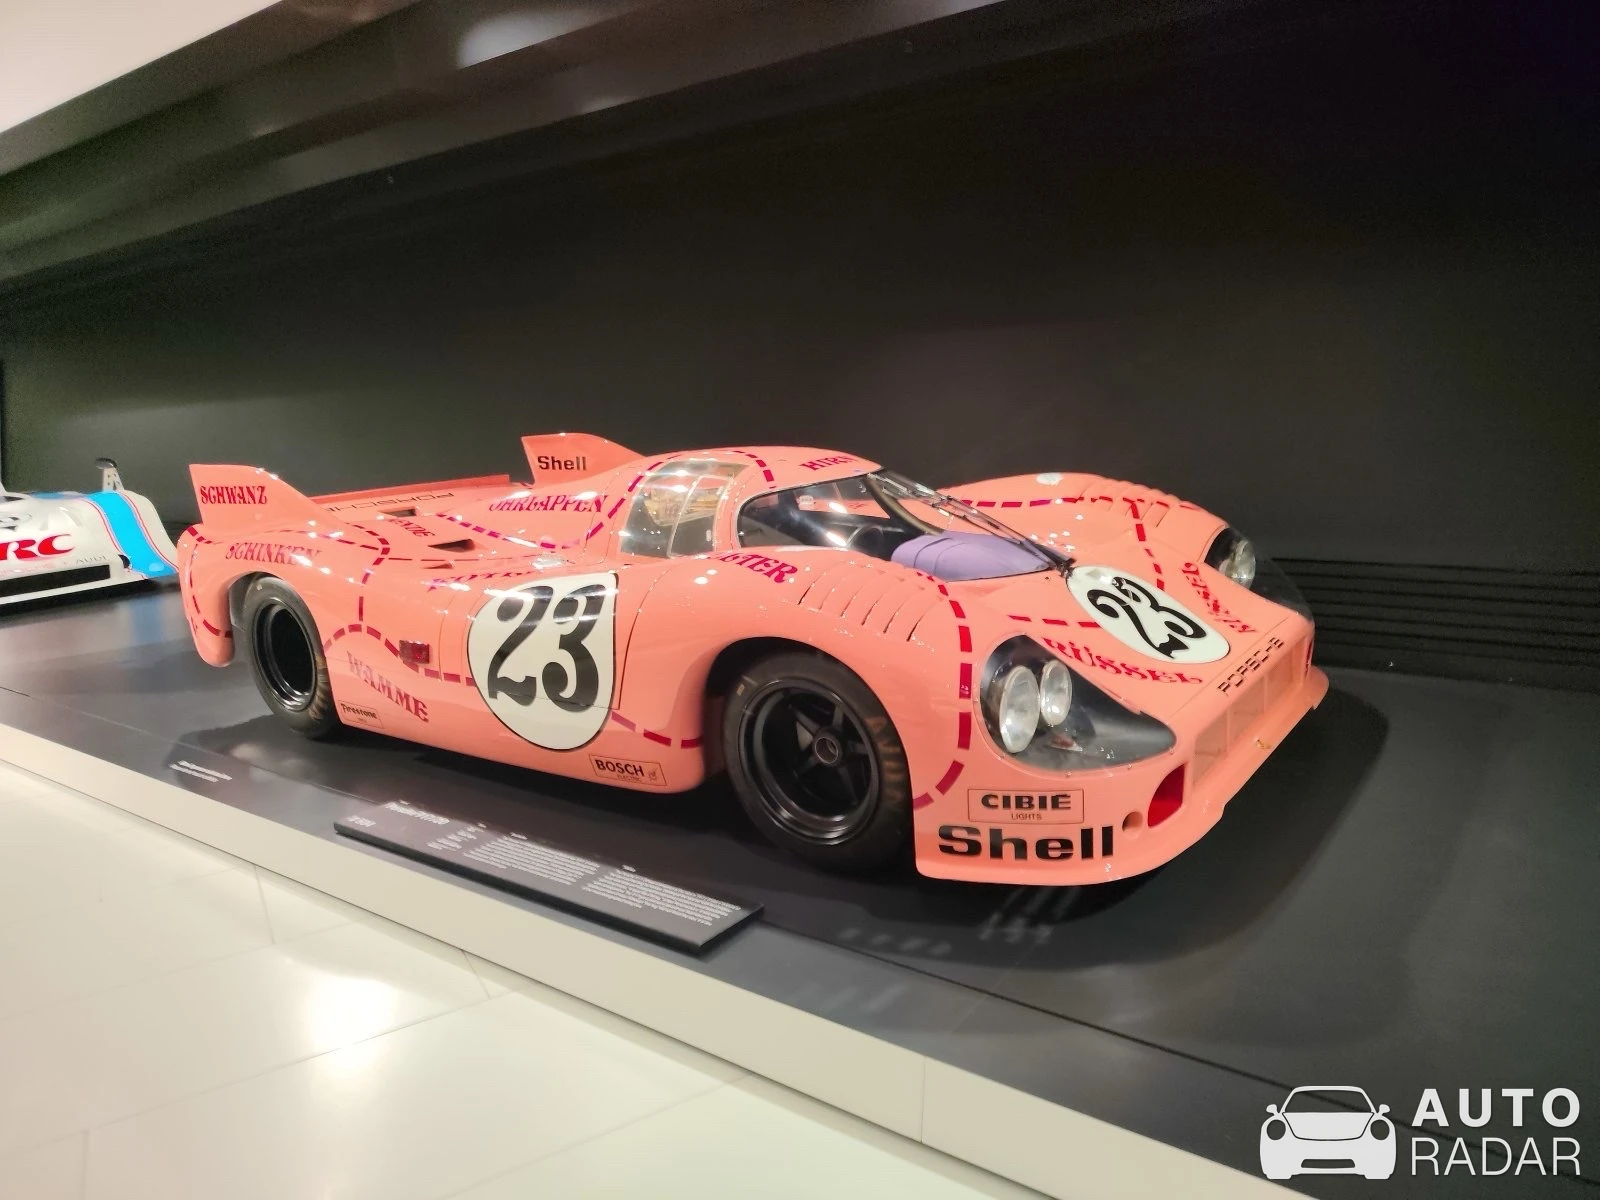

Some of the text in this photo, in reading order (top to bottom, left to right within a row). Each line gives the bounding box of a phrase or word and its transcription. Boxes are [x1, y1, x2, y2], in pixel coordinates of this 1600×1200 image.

[537, 455, 587, 471] Shell
[200, 485, 268, 505] SCHWANZ
[1086, 576, 1208, 660] 23
[487, 584, 606, 712] 23
[594, 759, 645, 777] BOSCH
[938, 824, 1114, 860] Shell
